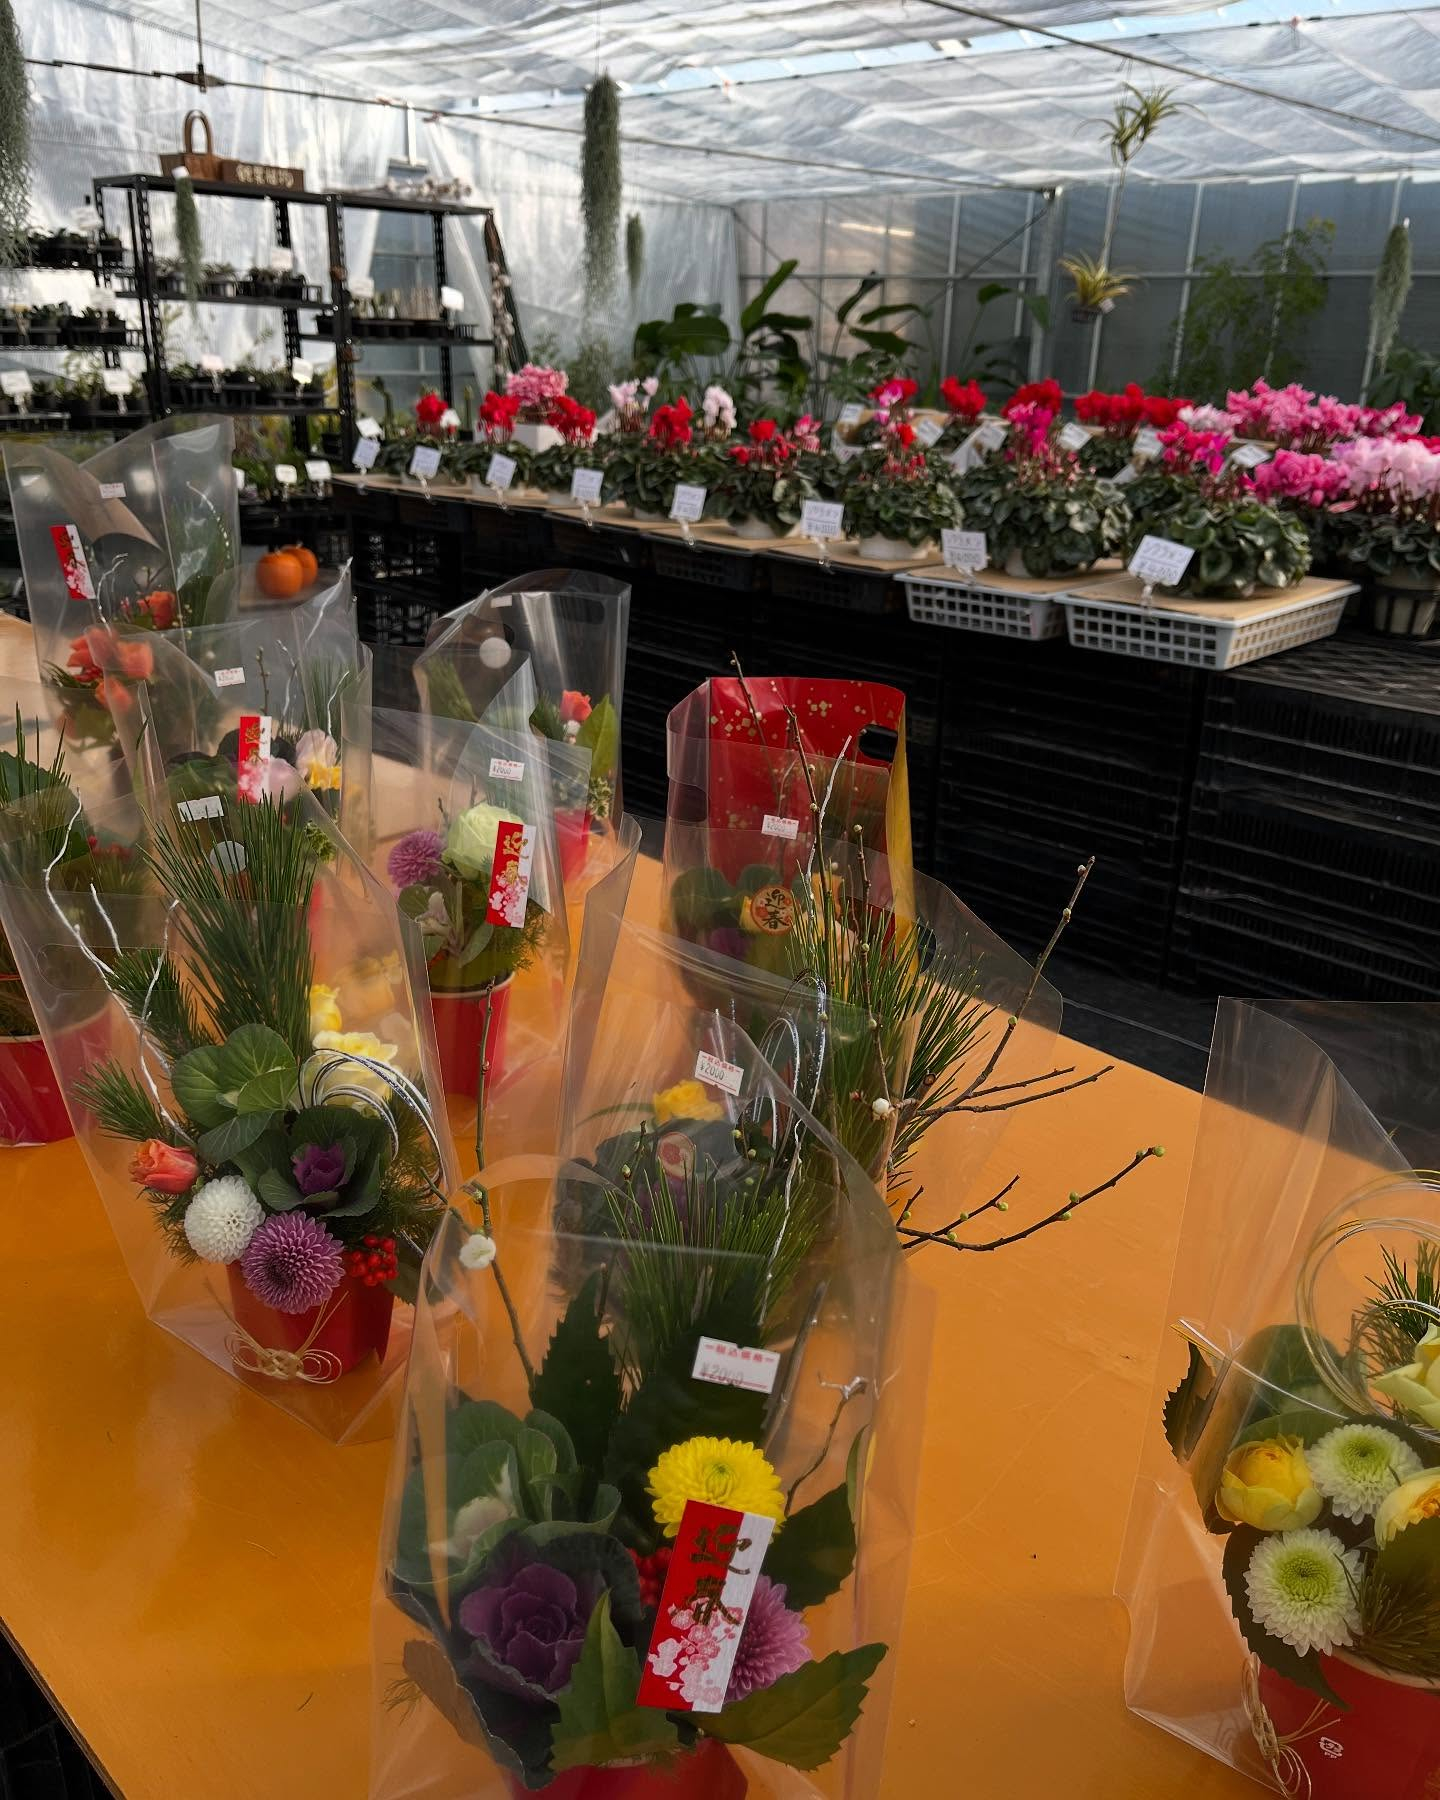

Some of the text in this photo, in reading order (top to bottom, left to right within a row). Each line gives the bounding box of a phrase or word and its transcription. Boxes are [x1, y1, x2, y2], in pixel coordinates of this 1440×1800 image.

[761, 888, 790, 930] 迎春
[700, 1060, 725, 1081] ¥2000
[702, 1362, 744, 1386] ¥2000
[685, 1523, 752, 1626] 迎春
